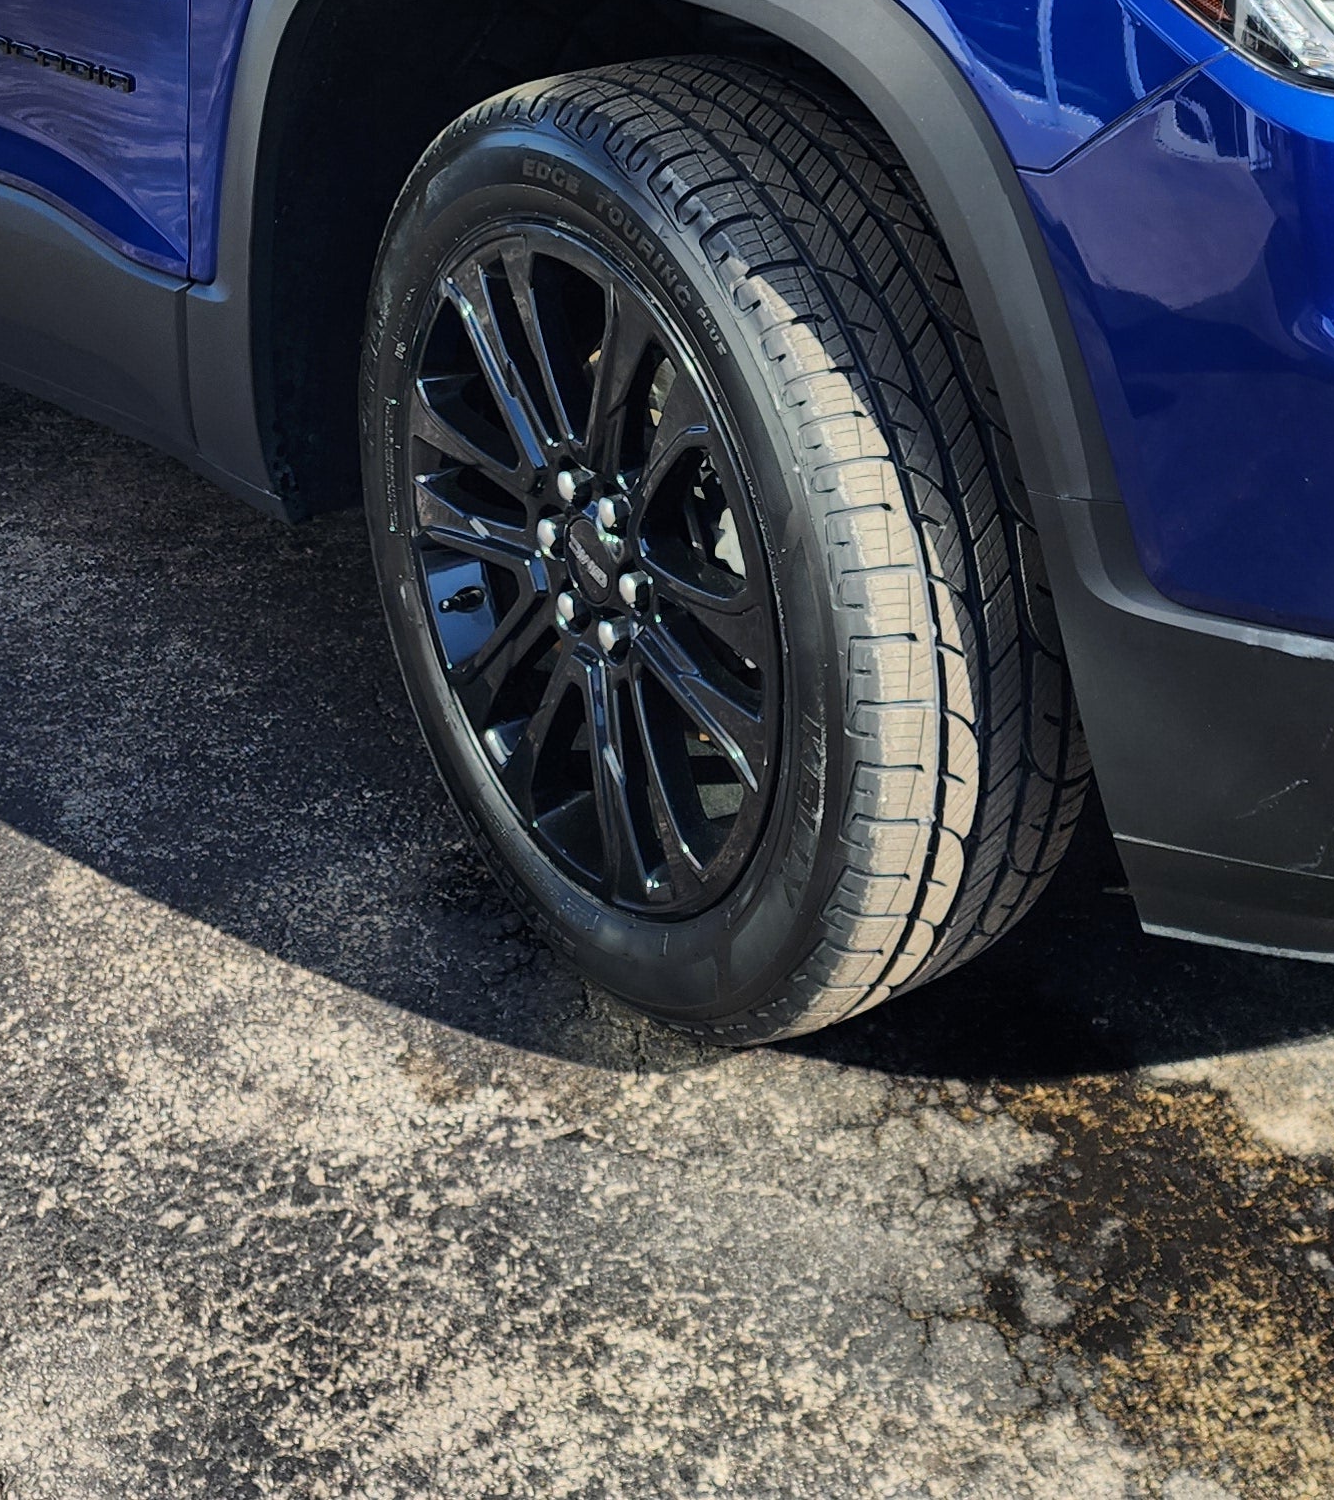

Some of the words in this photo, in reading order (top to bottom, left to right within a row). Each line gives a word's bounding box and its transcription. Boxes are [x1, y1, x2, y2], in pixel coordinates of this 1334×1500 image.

[522, 158, 583, 196] EDGE
[595, 190, 692, 309] TOURING
[696, 307, 728, 356] PLUS
